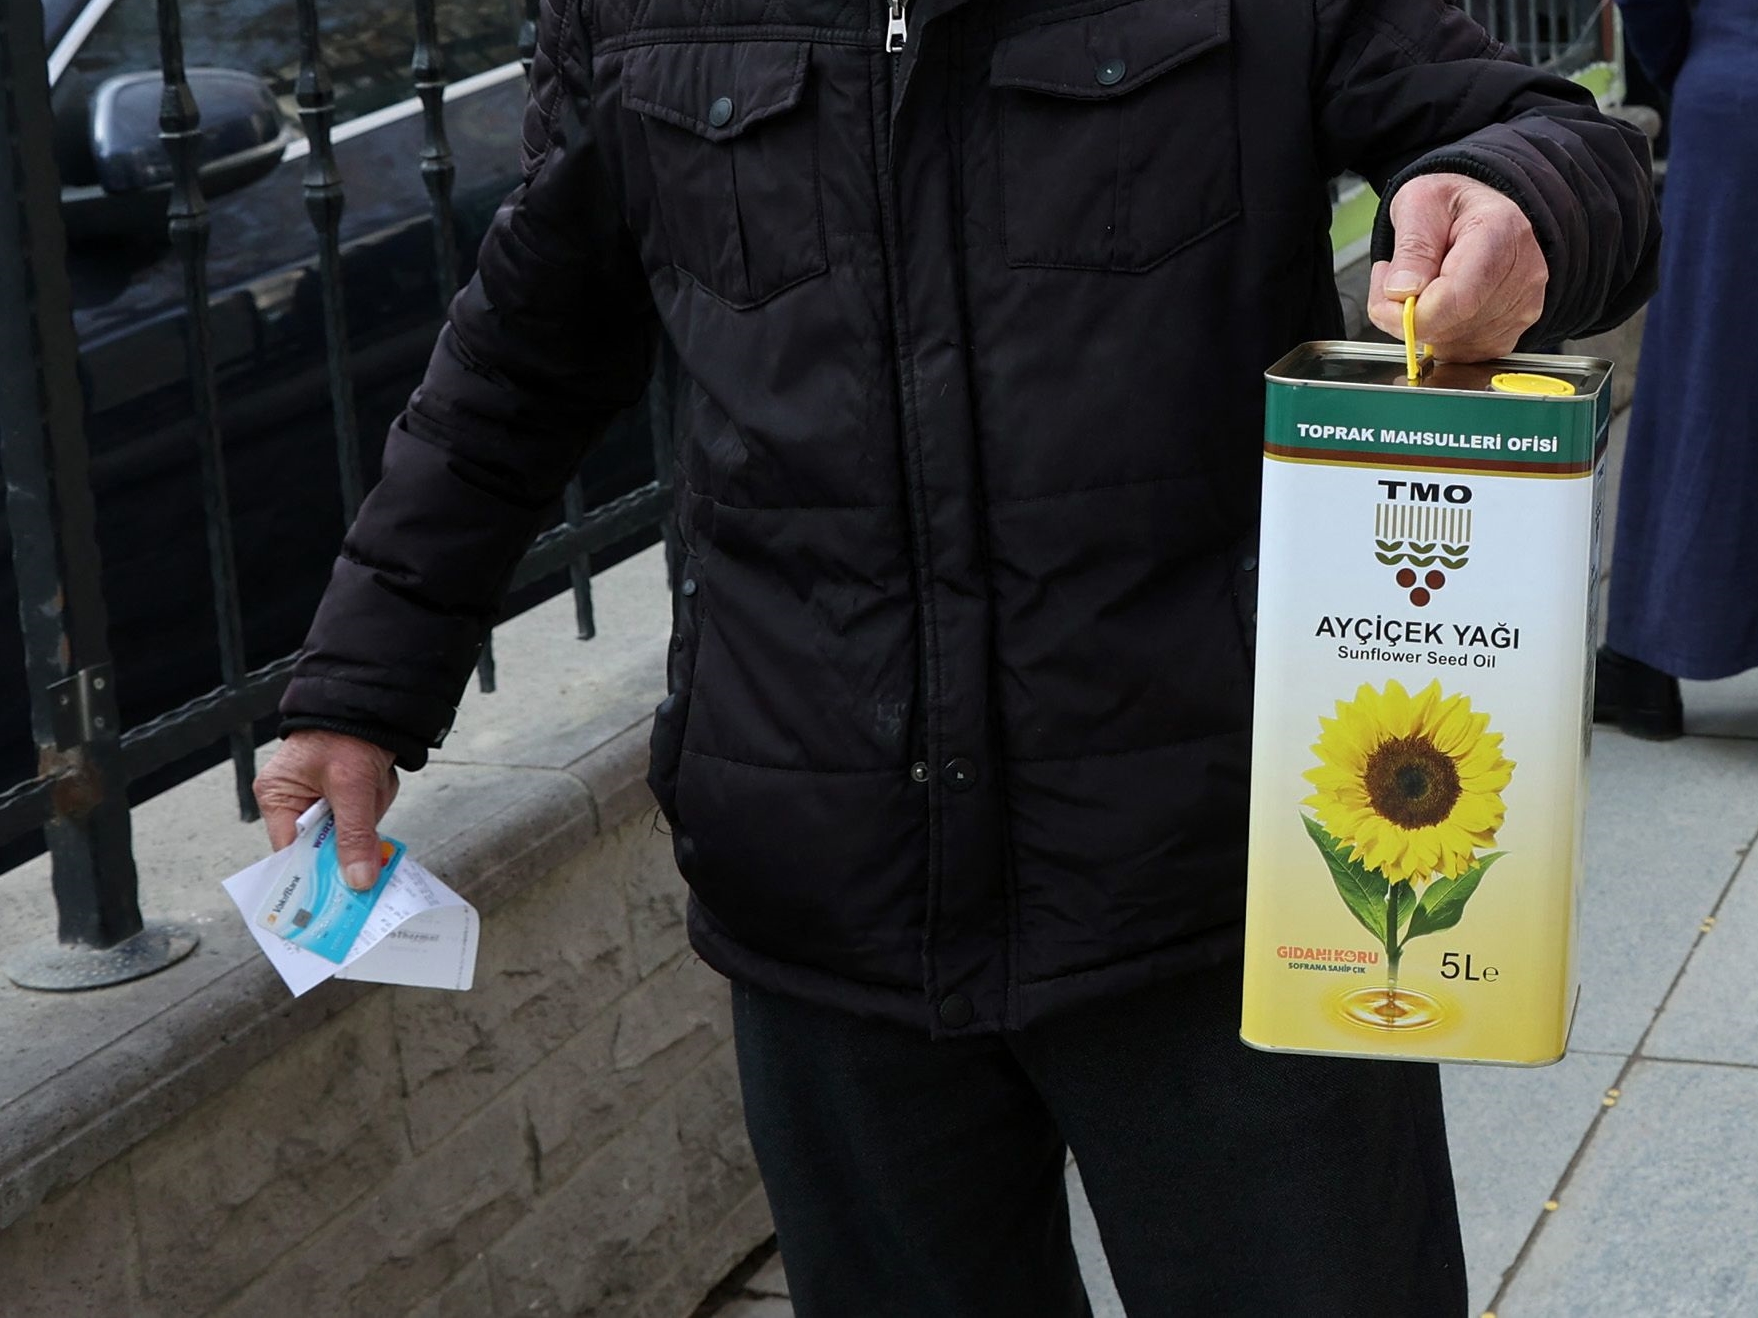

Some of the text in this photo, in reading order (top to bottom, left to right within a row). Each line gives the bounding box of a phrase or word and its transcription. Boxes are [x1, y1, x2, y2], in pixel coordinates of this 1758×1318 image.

[1296, 423, 1558, 453] TOPRAK MAHSULLERİ OFİSİ
[1378, 480, 1473, 504] TMO
[1315, 615, 1519, 649] AYÇİÇEK YAĞI
[1338, 645, 1496, 668] Sunflower Seed Oil
[1276, 945, 1379, 965] GIDANI KORU
[1288, 962, 1327, 972] SOFRANA
